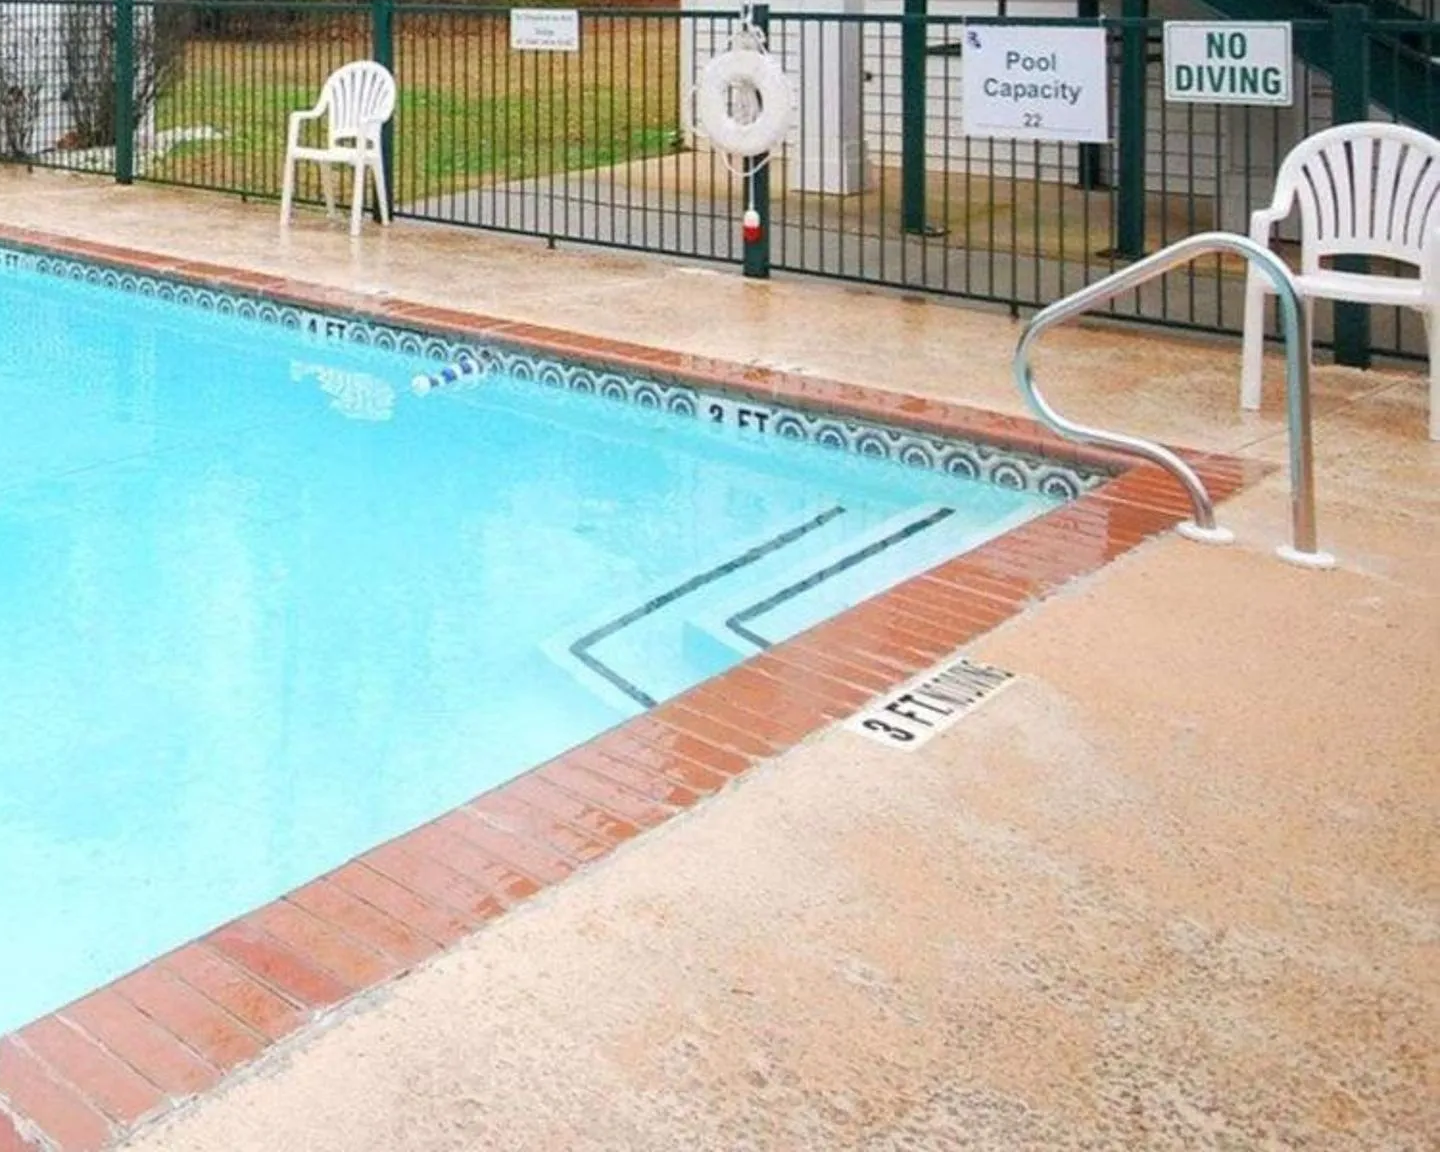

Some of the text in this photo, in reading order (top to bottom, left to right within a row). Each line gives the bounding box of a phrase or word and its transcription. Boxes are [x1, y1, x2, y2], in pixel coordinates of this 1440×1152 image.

[1206, 32, 1247, 60] NO
[1006, 51, 1057, 72] Pool
[983, 77, 1082, 105] Capacity
[1175, 65, 1281, 95] DIVING
[1023, 112, 1042, 128] 22
[862, 694, 955, 742] 3 FT
